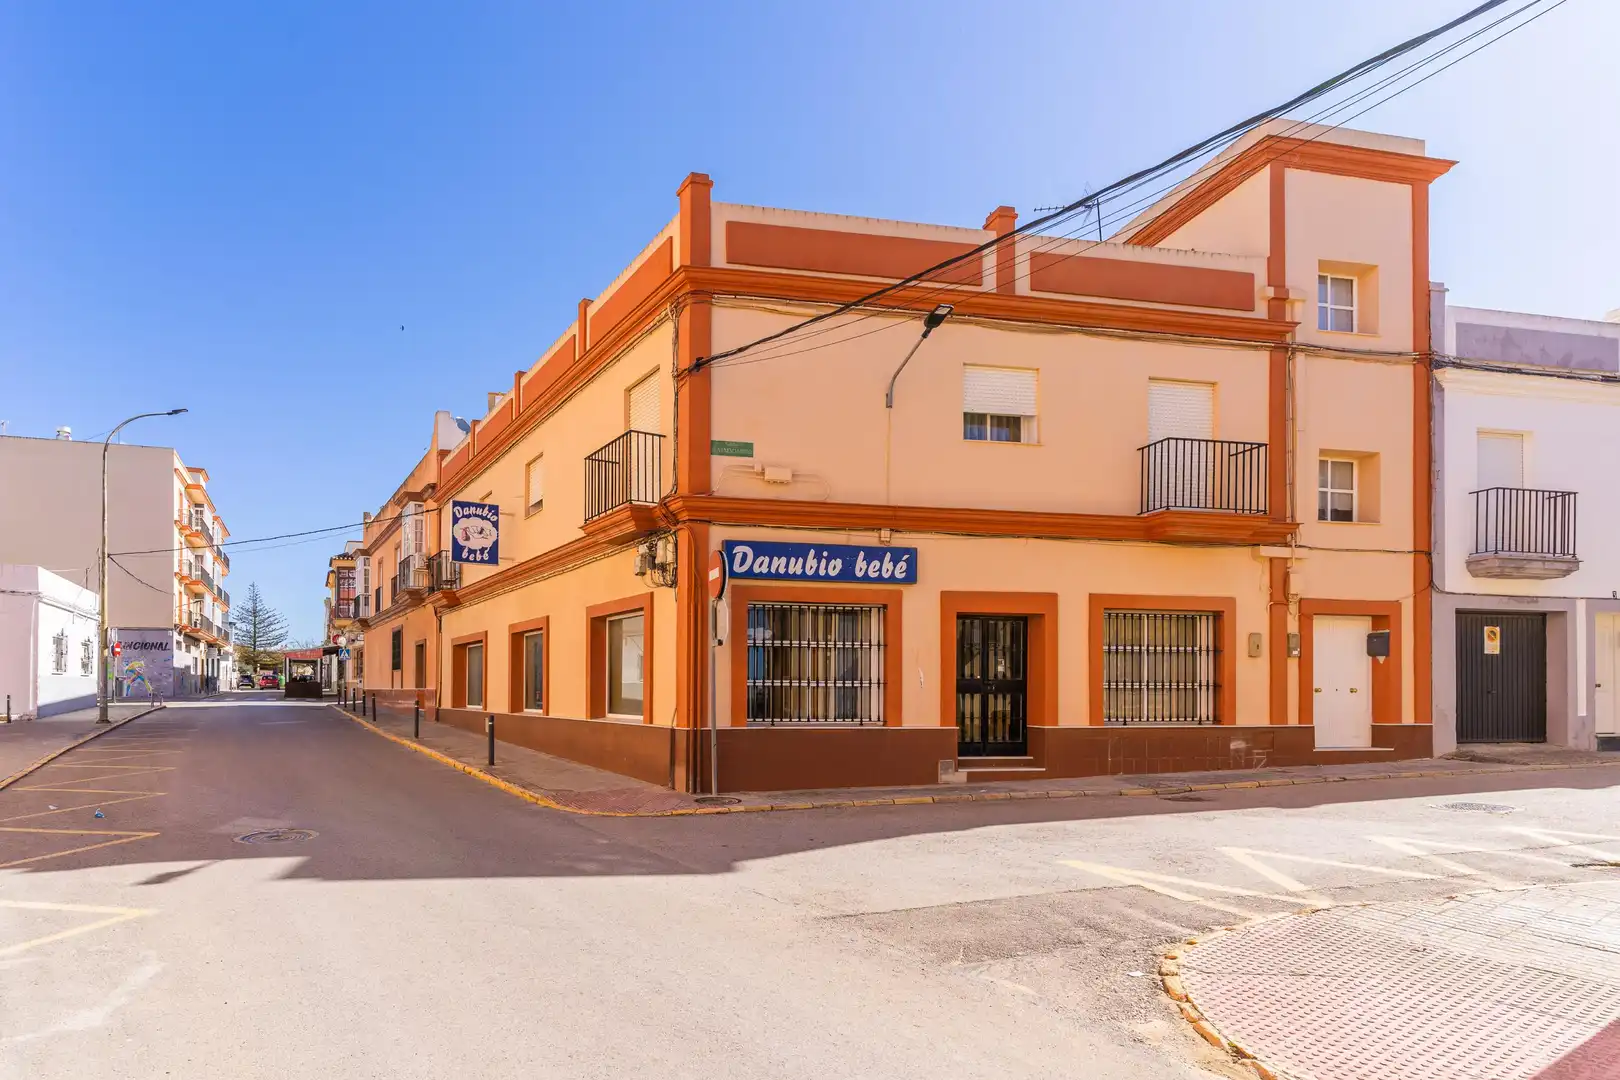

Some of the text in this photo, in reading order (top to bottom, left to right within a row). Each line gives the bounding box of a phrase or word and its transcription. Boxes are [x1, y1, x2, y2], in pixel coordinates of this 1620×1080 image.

[453, 505, 498, 522] Danubio
[732, 545, 910, 579] Danubio bebé
